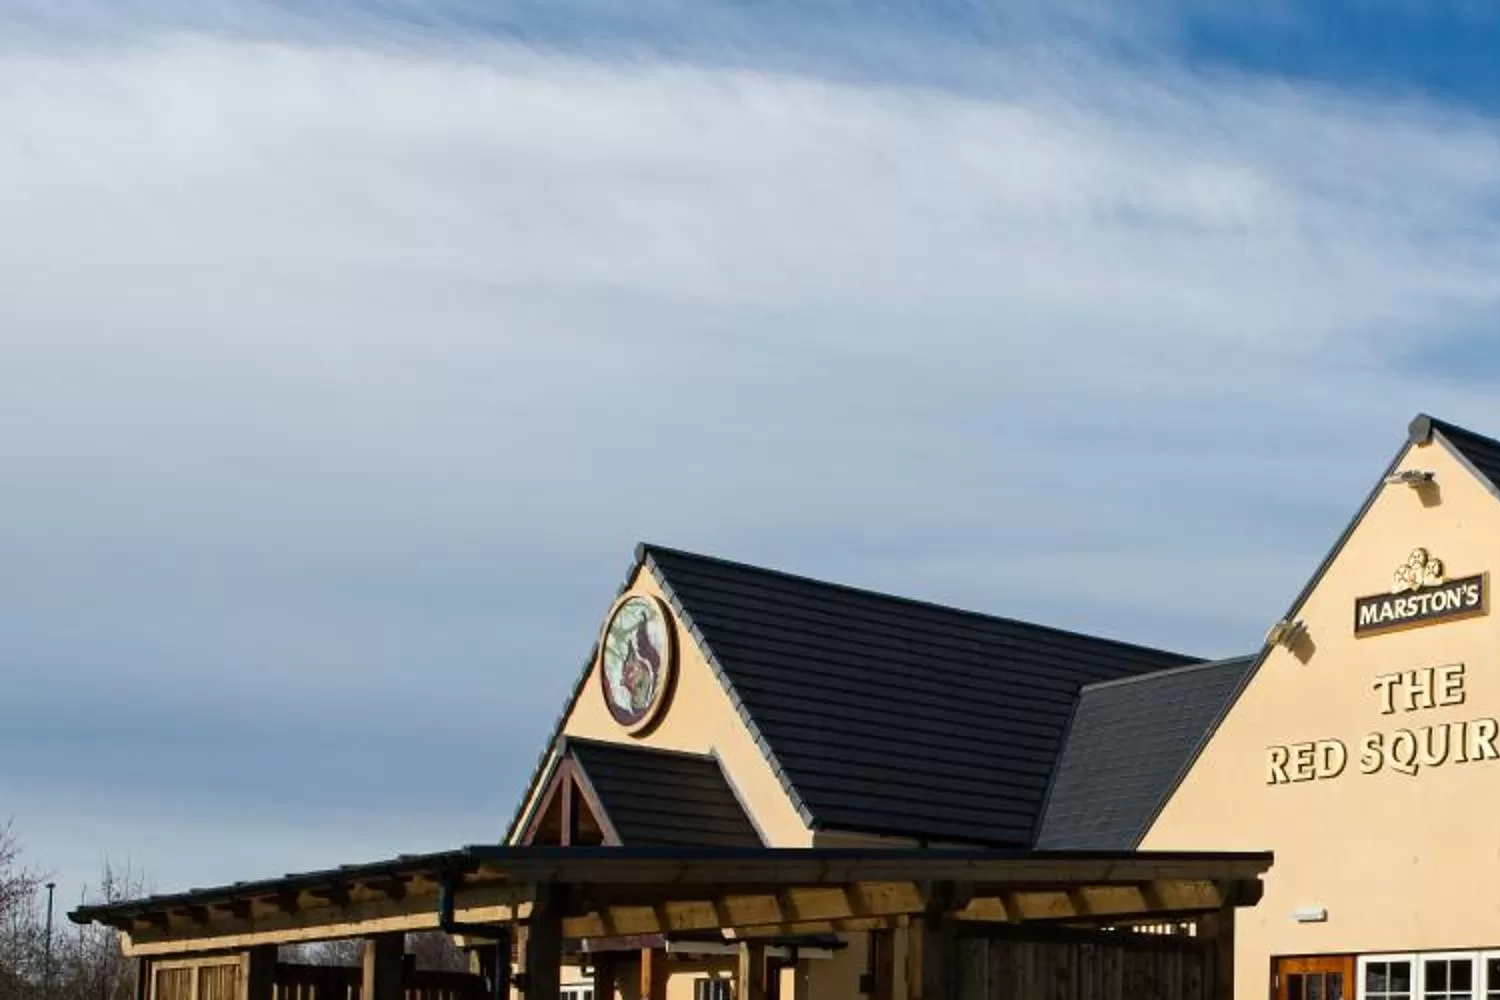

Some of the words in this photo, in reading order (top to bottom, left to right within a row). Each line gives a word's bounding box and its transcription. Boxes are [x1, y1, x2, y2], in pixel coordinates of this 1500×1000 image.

[1360, 584, 1479, 625] MARSTON'S
[1372, 664, 1466, 715] THE
[1265, 737, 1348, 785] RED
